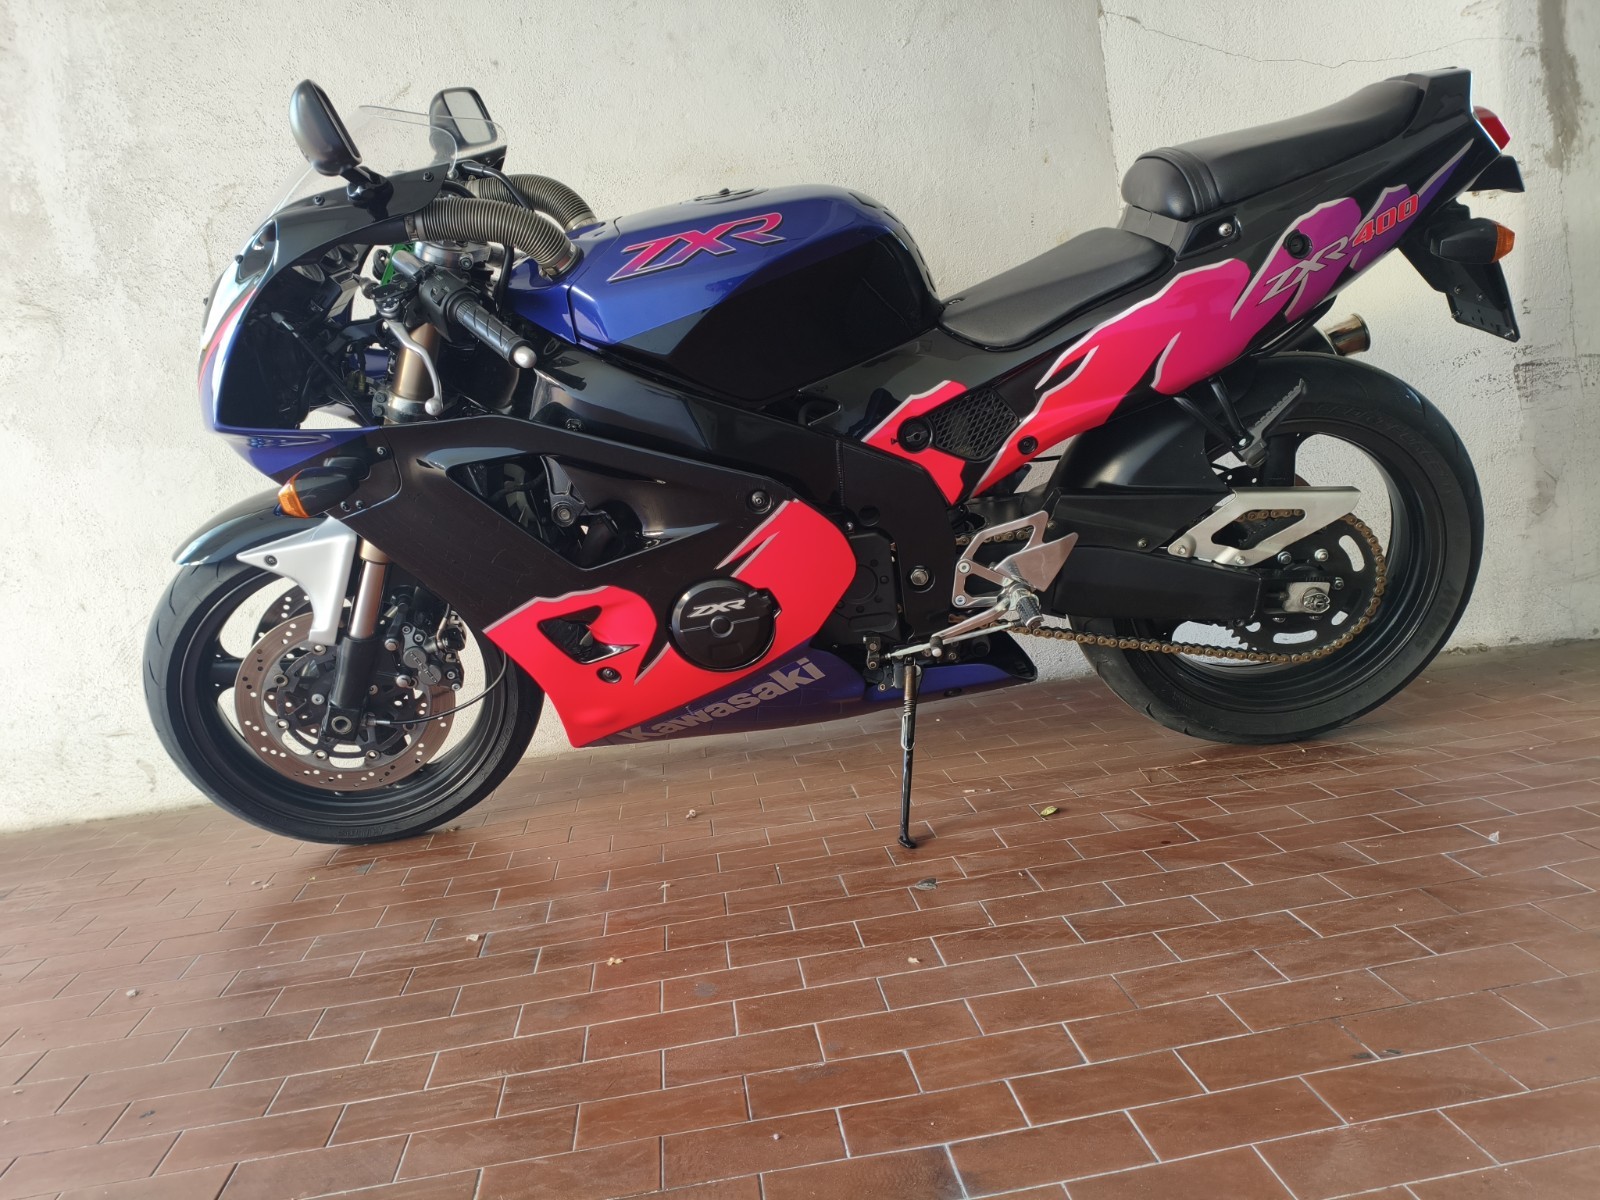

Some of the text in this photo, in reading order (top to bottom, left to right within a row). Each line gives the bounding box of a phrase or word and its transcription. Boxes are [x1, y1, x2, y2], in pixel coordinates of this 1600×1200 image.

[606, 212, 786, 282] ZXR
[1257, 194, 1419, 306] ZXR 400
[687, 599, 746, 618] ZXR
[617, 657, 826, 742] Kawasaki
